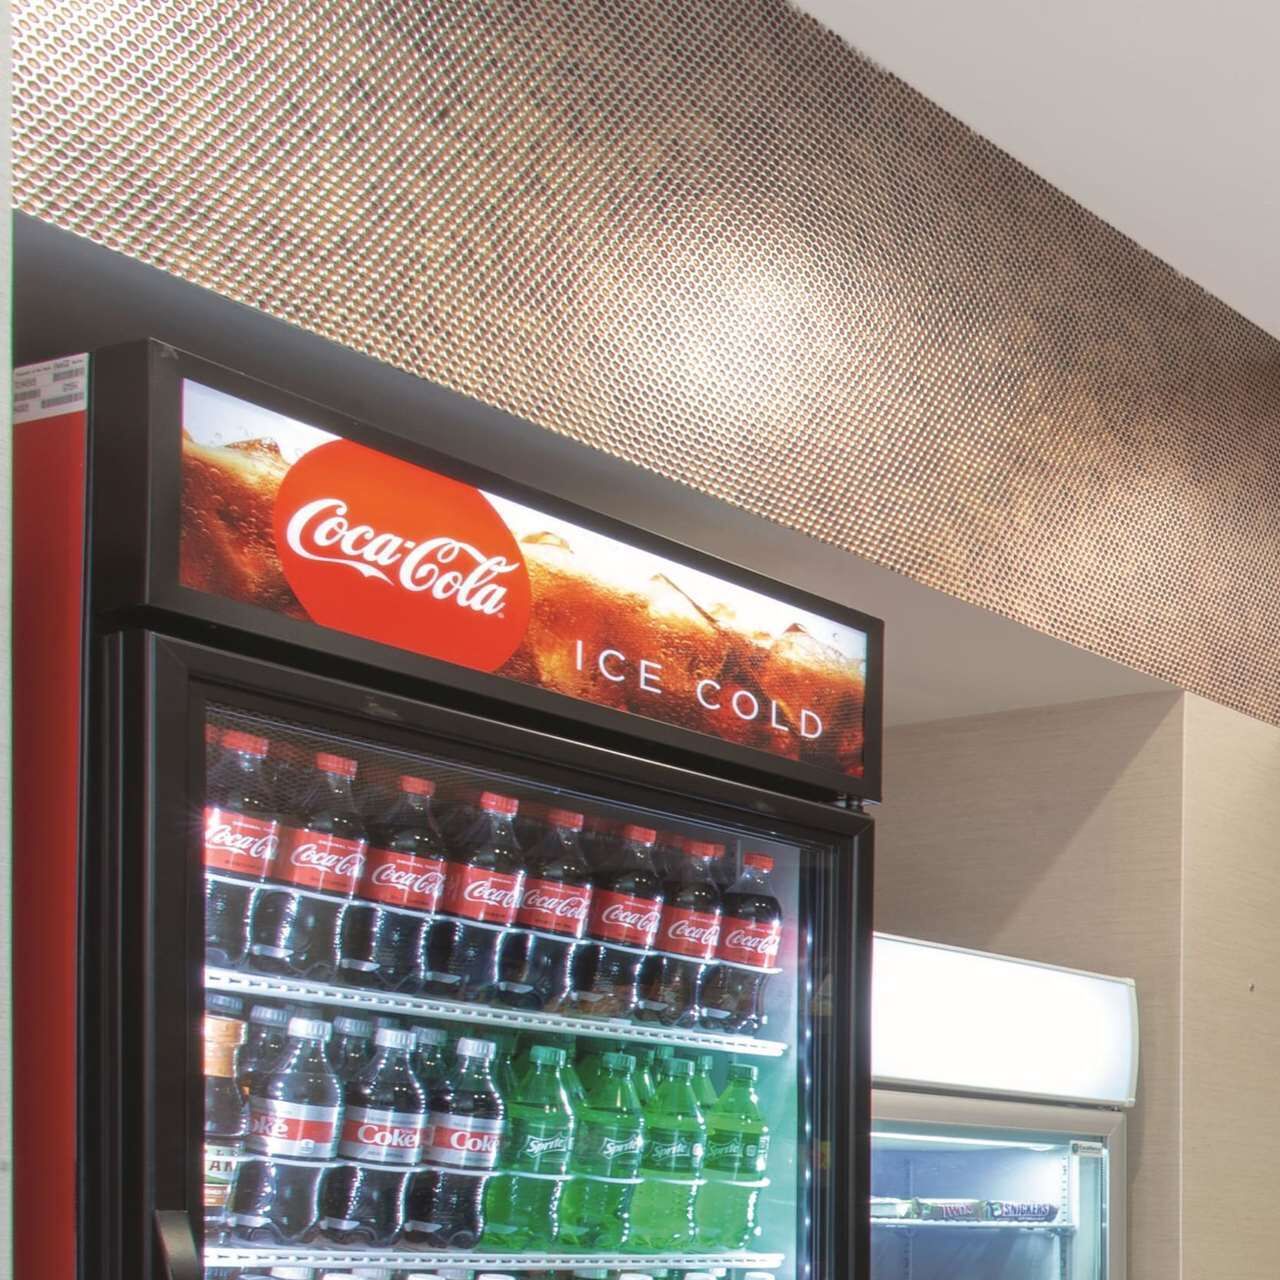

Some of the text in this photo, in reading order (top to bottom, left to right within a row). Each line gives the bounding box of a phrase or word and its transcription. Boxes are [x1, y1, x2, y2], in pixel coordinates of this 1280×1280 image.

[287, 497, 521, 616] Coca-Cola
[575, 639, 824, 741] ICE COLD
[252, 1114, 288, 1138] oke
[357, 1124, 419, 1148] Coke
[1003, 1203, 1049, 1216] SNICKERS
